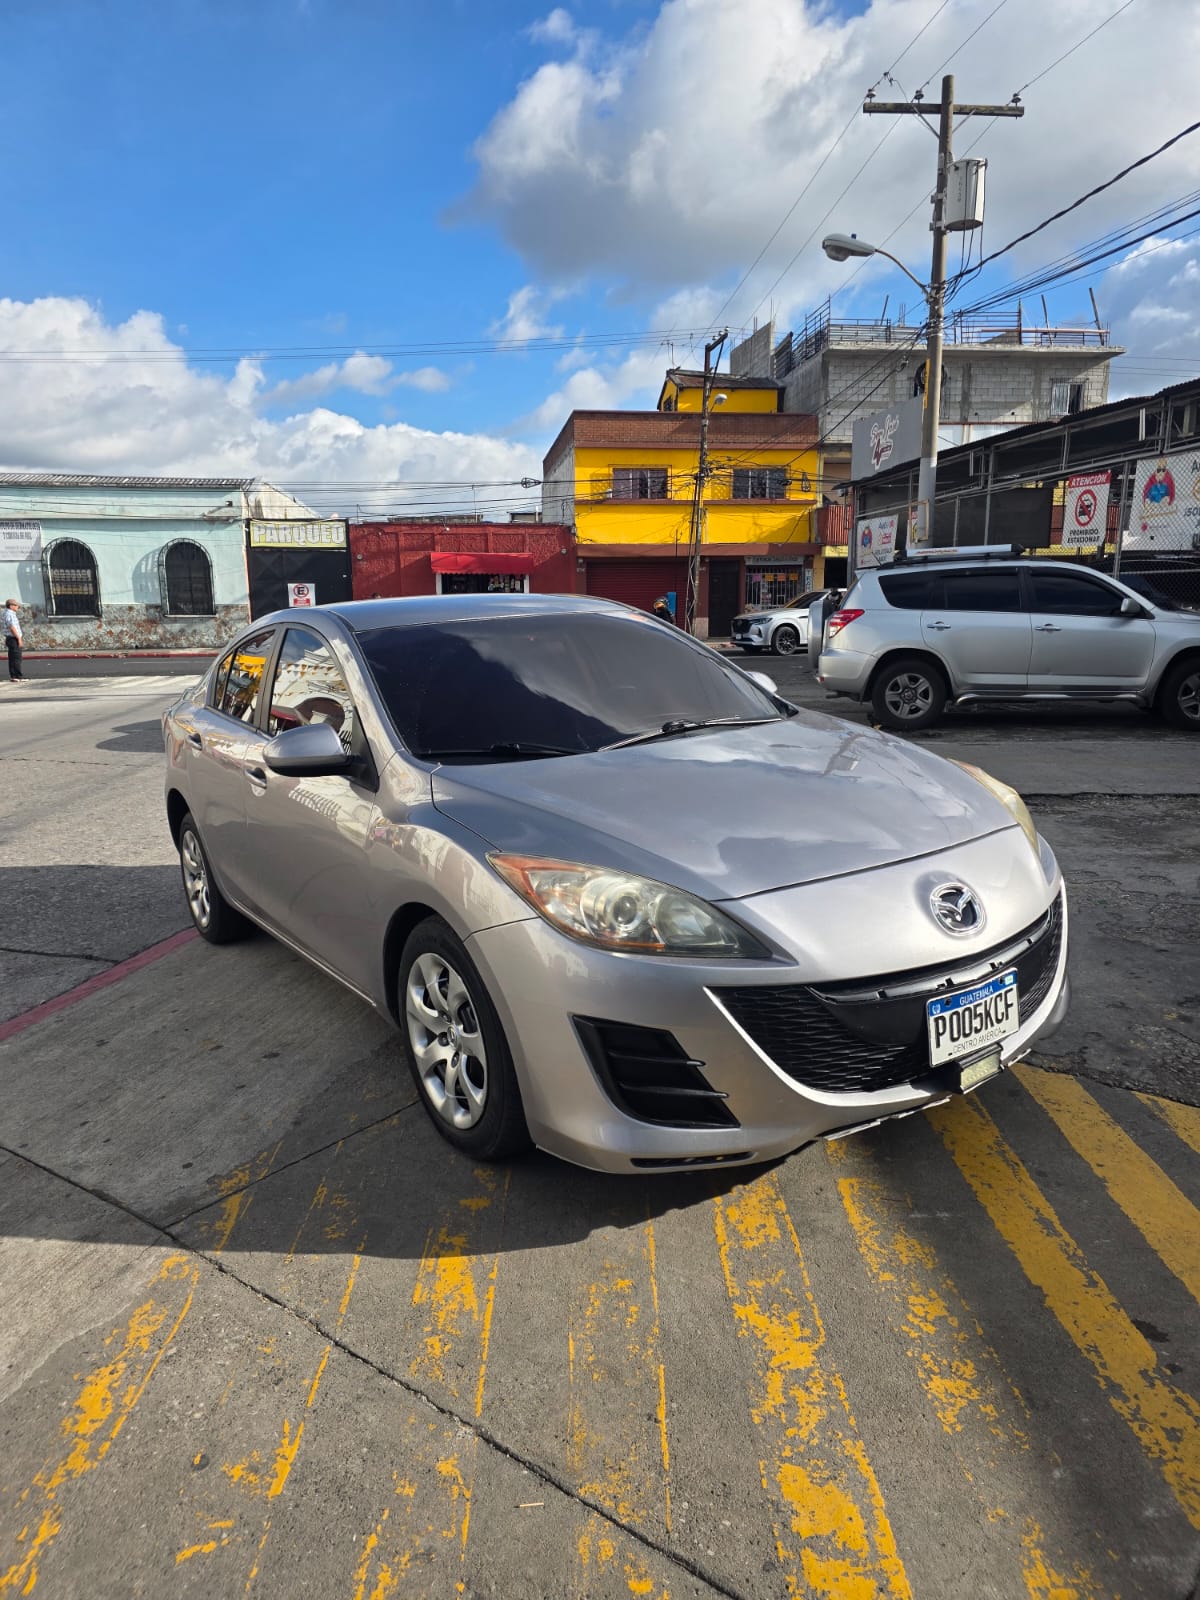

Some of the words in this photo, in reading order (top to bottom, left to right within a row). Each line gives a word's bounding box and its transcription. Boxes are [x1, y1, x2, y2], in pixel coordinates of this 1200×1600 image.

[253, 524, 345, 546] PARQUEO
[960, 985, 994, 1006] GUATEMALA
[952, 1035, 978, 1054] CENTRO
